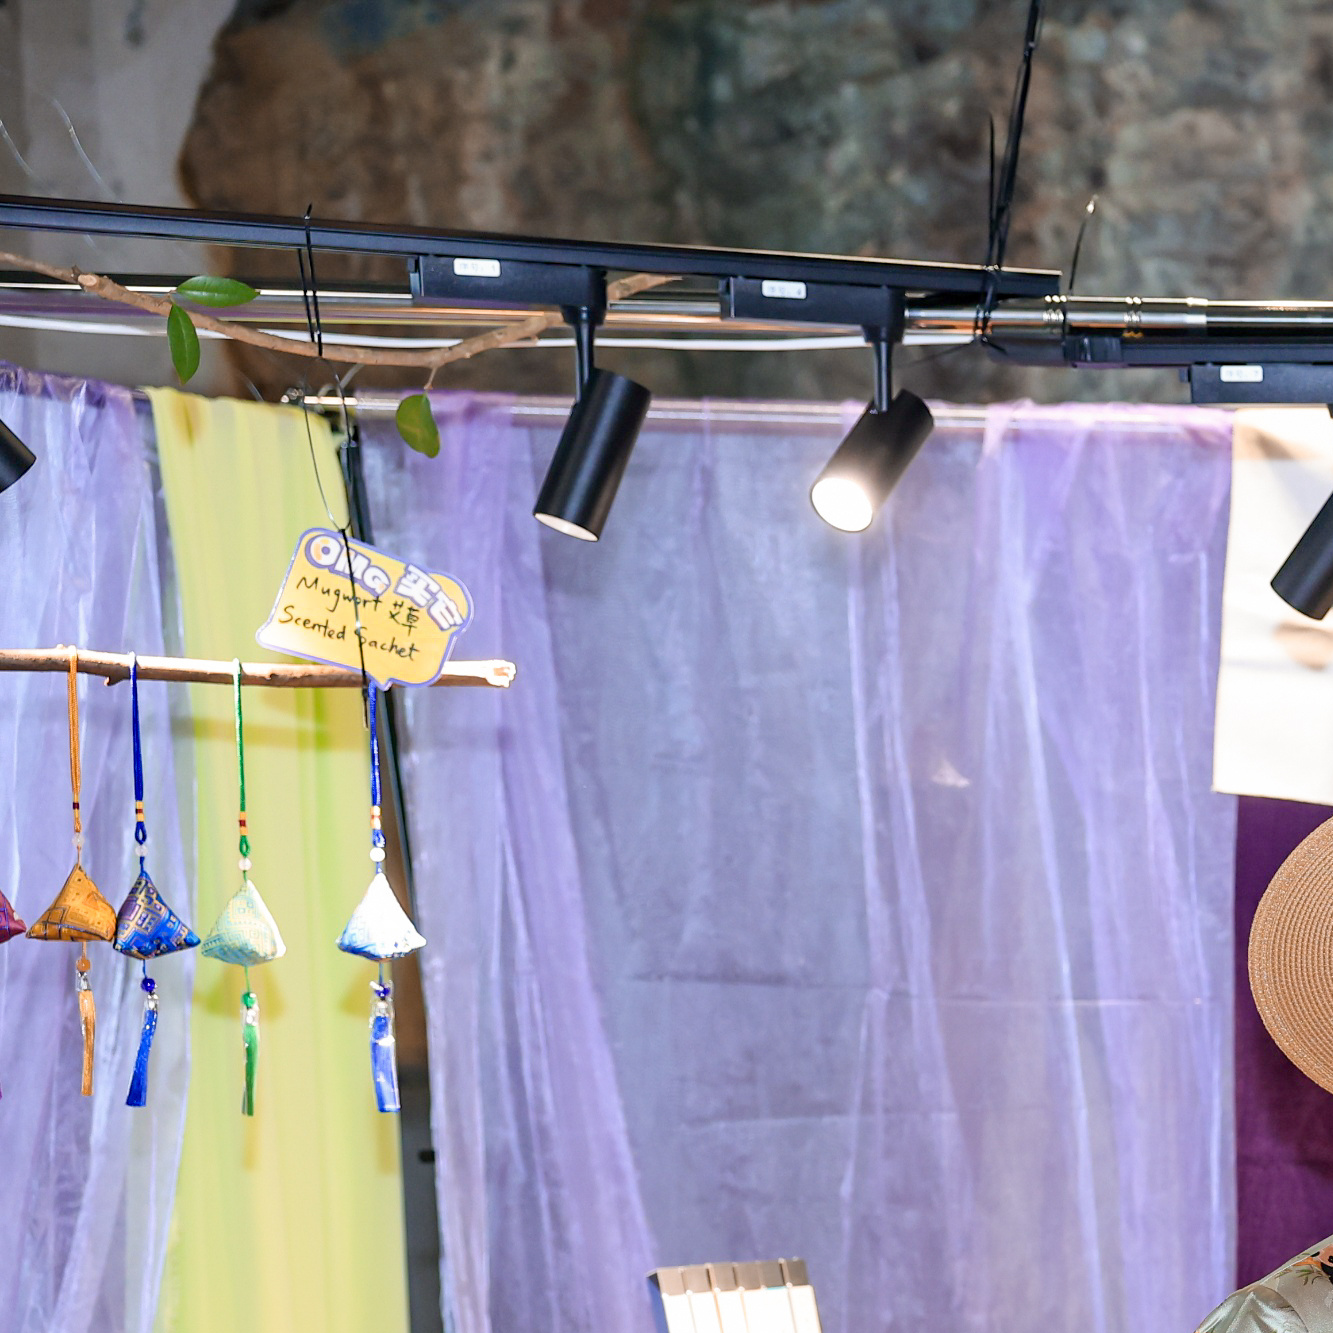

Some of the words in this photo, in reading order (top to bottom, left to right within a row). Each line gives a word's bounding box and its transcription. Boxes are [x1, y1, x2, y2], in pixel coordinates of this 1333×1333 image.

[309, 534, 391, 596] OMG
[278, 605, 347, 641] Scented
[354, 626, 421, 662] Sachet
